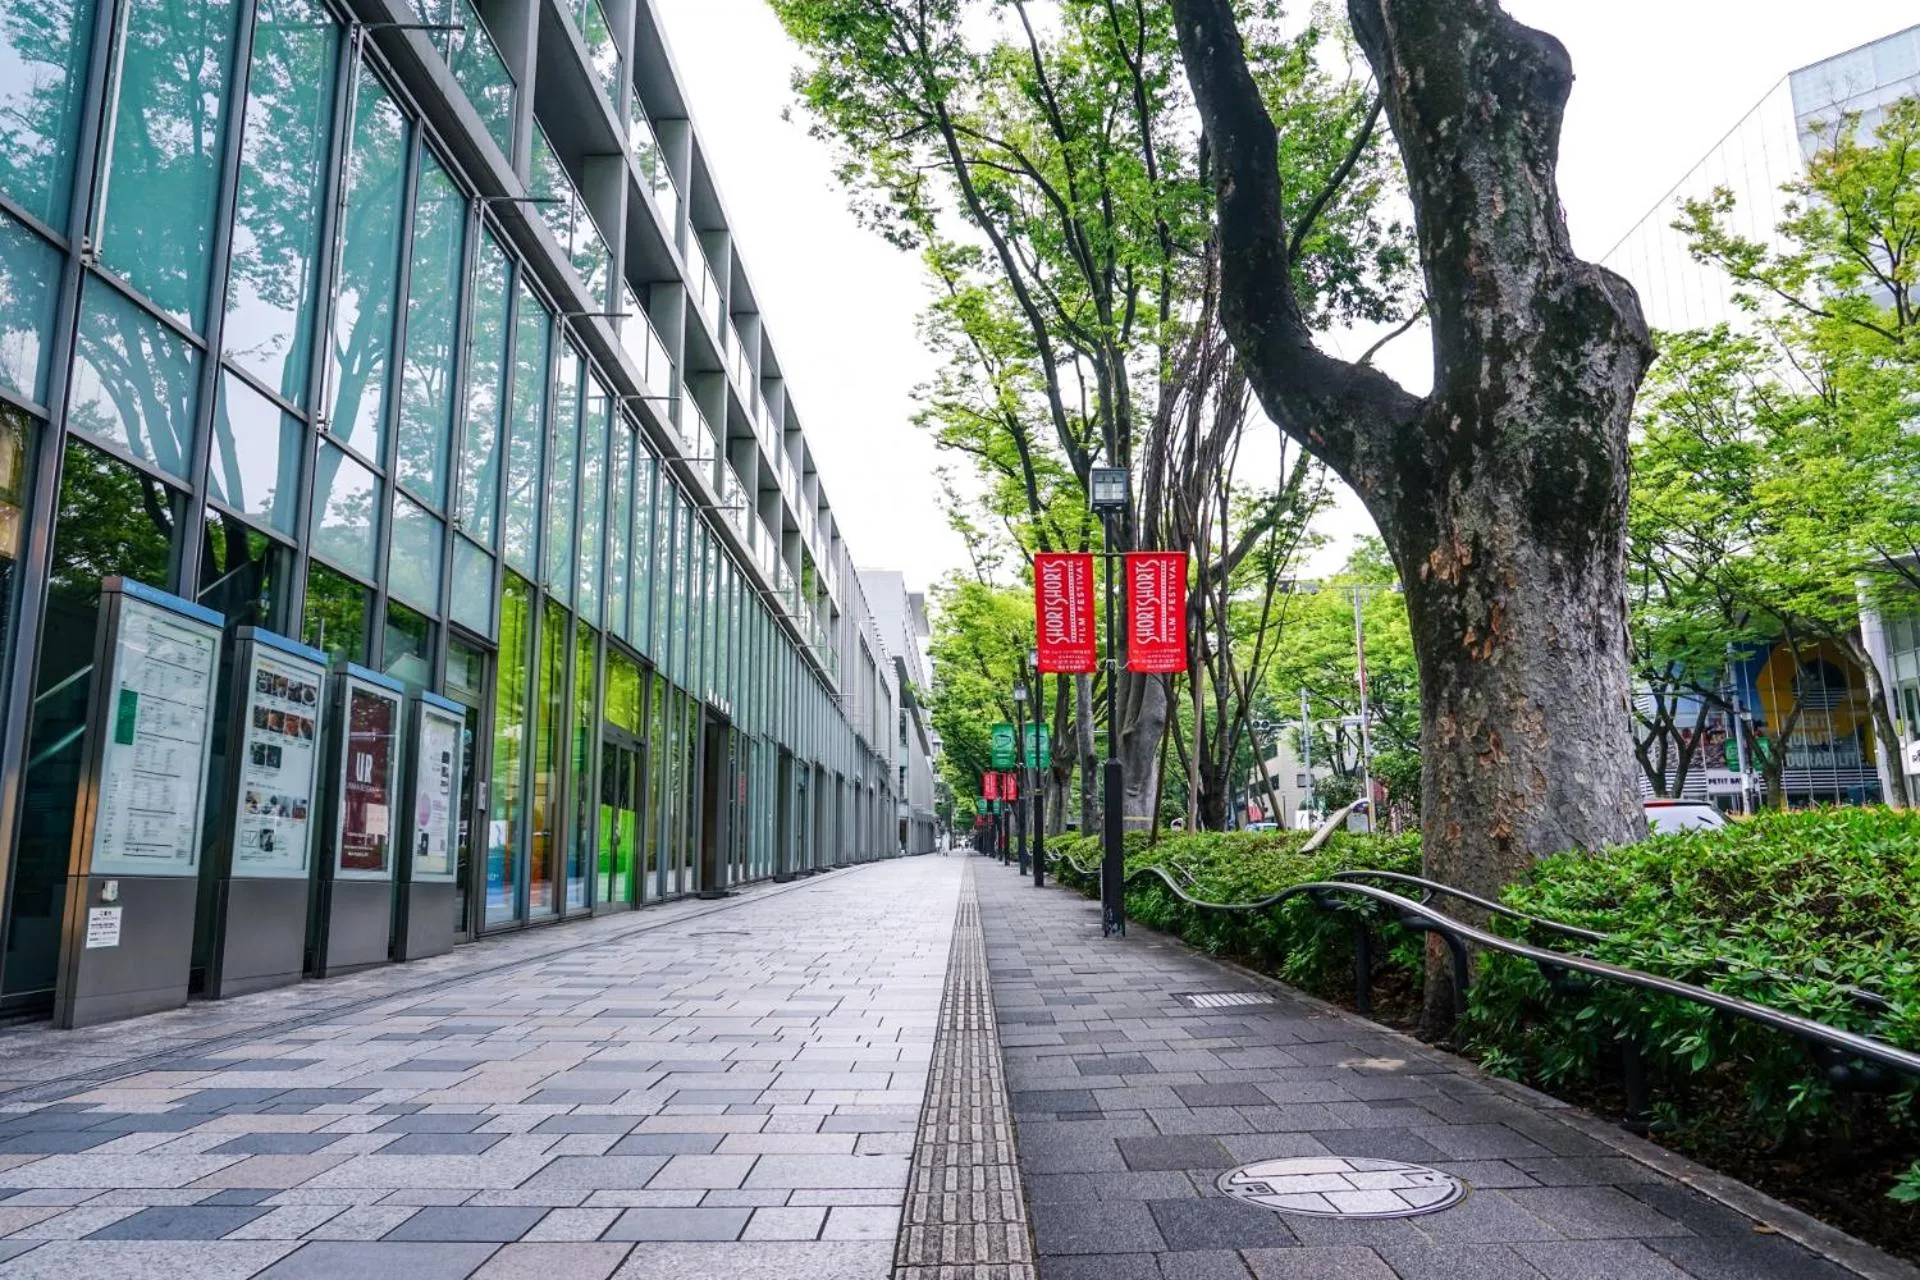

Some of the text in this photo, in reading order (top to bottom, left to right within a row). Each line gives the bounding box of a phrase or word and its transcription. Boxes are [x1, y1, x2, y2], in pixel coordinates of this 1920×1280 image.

[1076, 560, 1086, 644] FILM FESTIVAL
[1168, 560, 1177, 643] FILM FESTIVAL
[356, 753, 373, 783] UR
